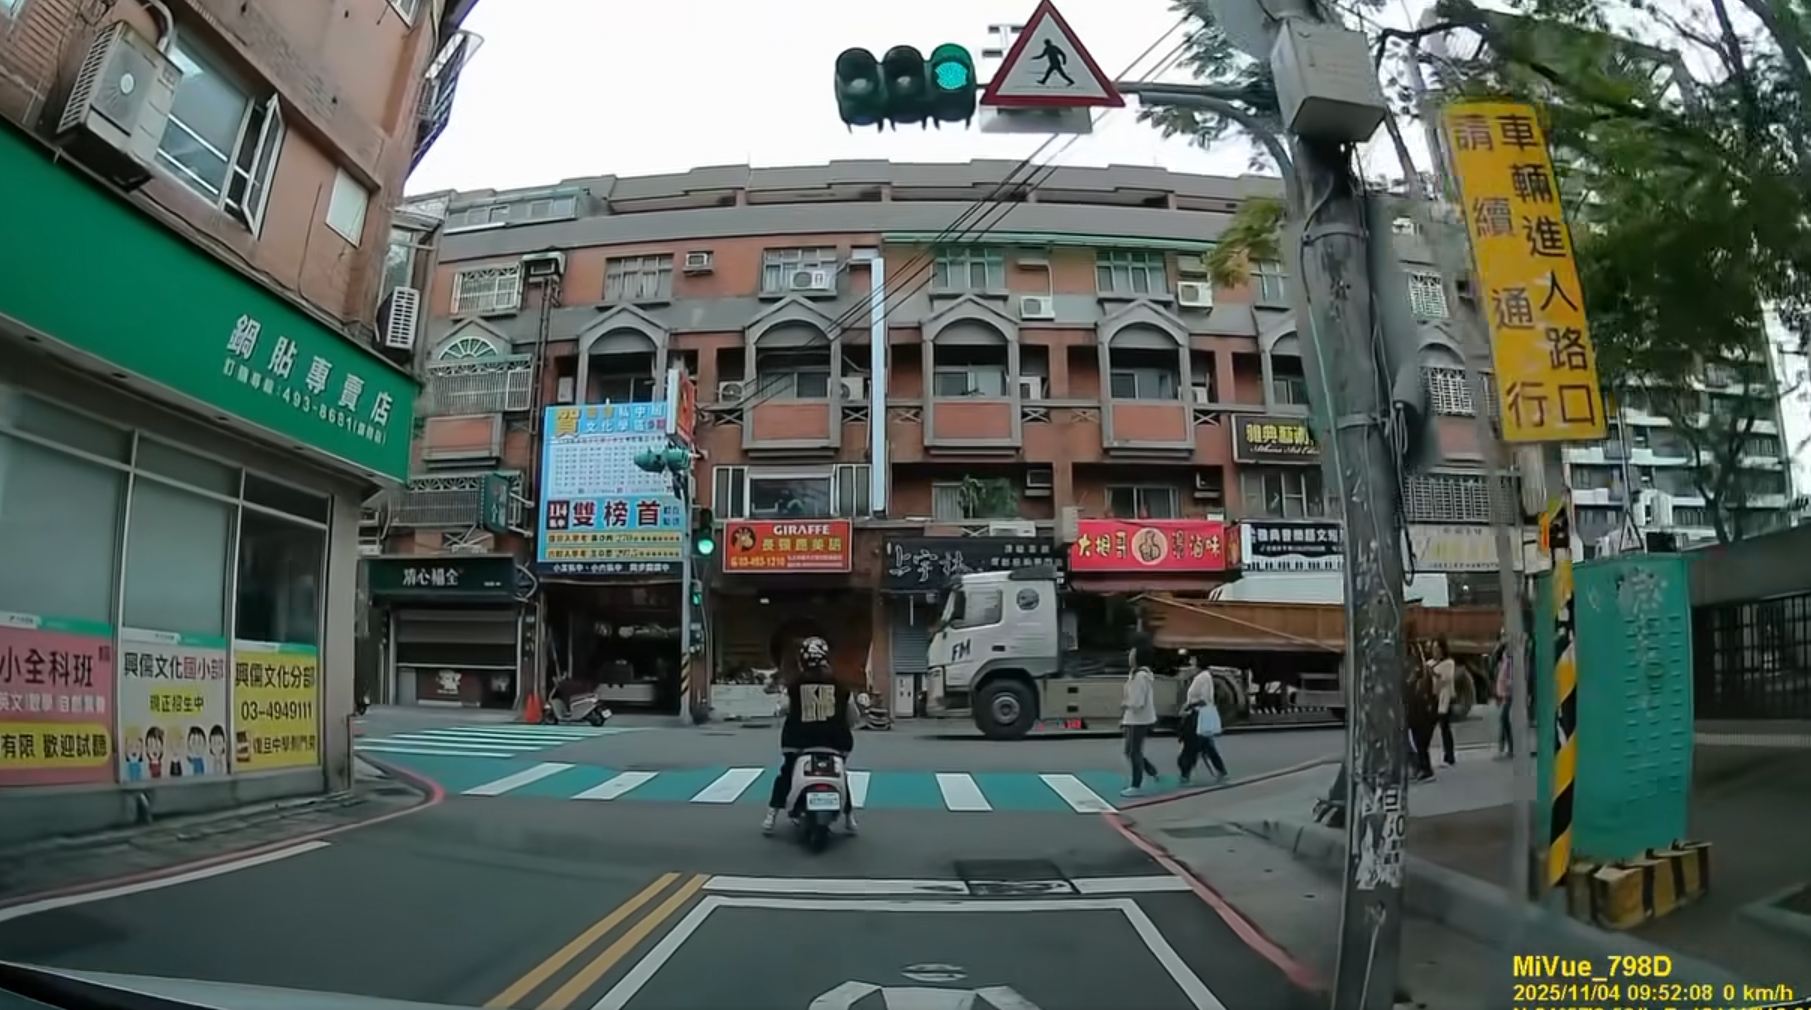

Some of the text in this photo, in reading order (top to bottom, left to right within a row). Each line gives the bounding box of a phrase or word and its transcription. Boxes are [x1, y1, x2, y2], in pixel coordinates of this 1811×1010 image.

[1453, 114, 1548, 429] 請續通行
[226, 313, 393, 427] 鍋貼專賣店
[572, 500, 661, 528] 雙榜首
[773, 524, 830, 536] GIRAFFE
[951, 637, 972, 662] FM
[123, 651, 225, 681] 興儒文化國小部
[235, 661, 316, 689] 興儒文化分部
[149, 694, 205, 713] 現正招生中
[241, 701, 312, 721] 03-4949111
[42, 732, 108, 759] 歡迎試聽
